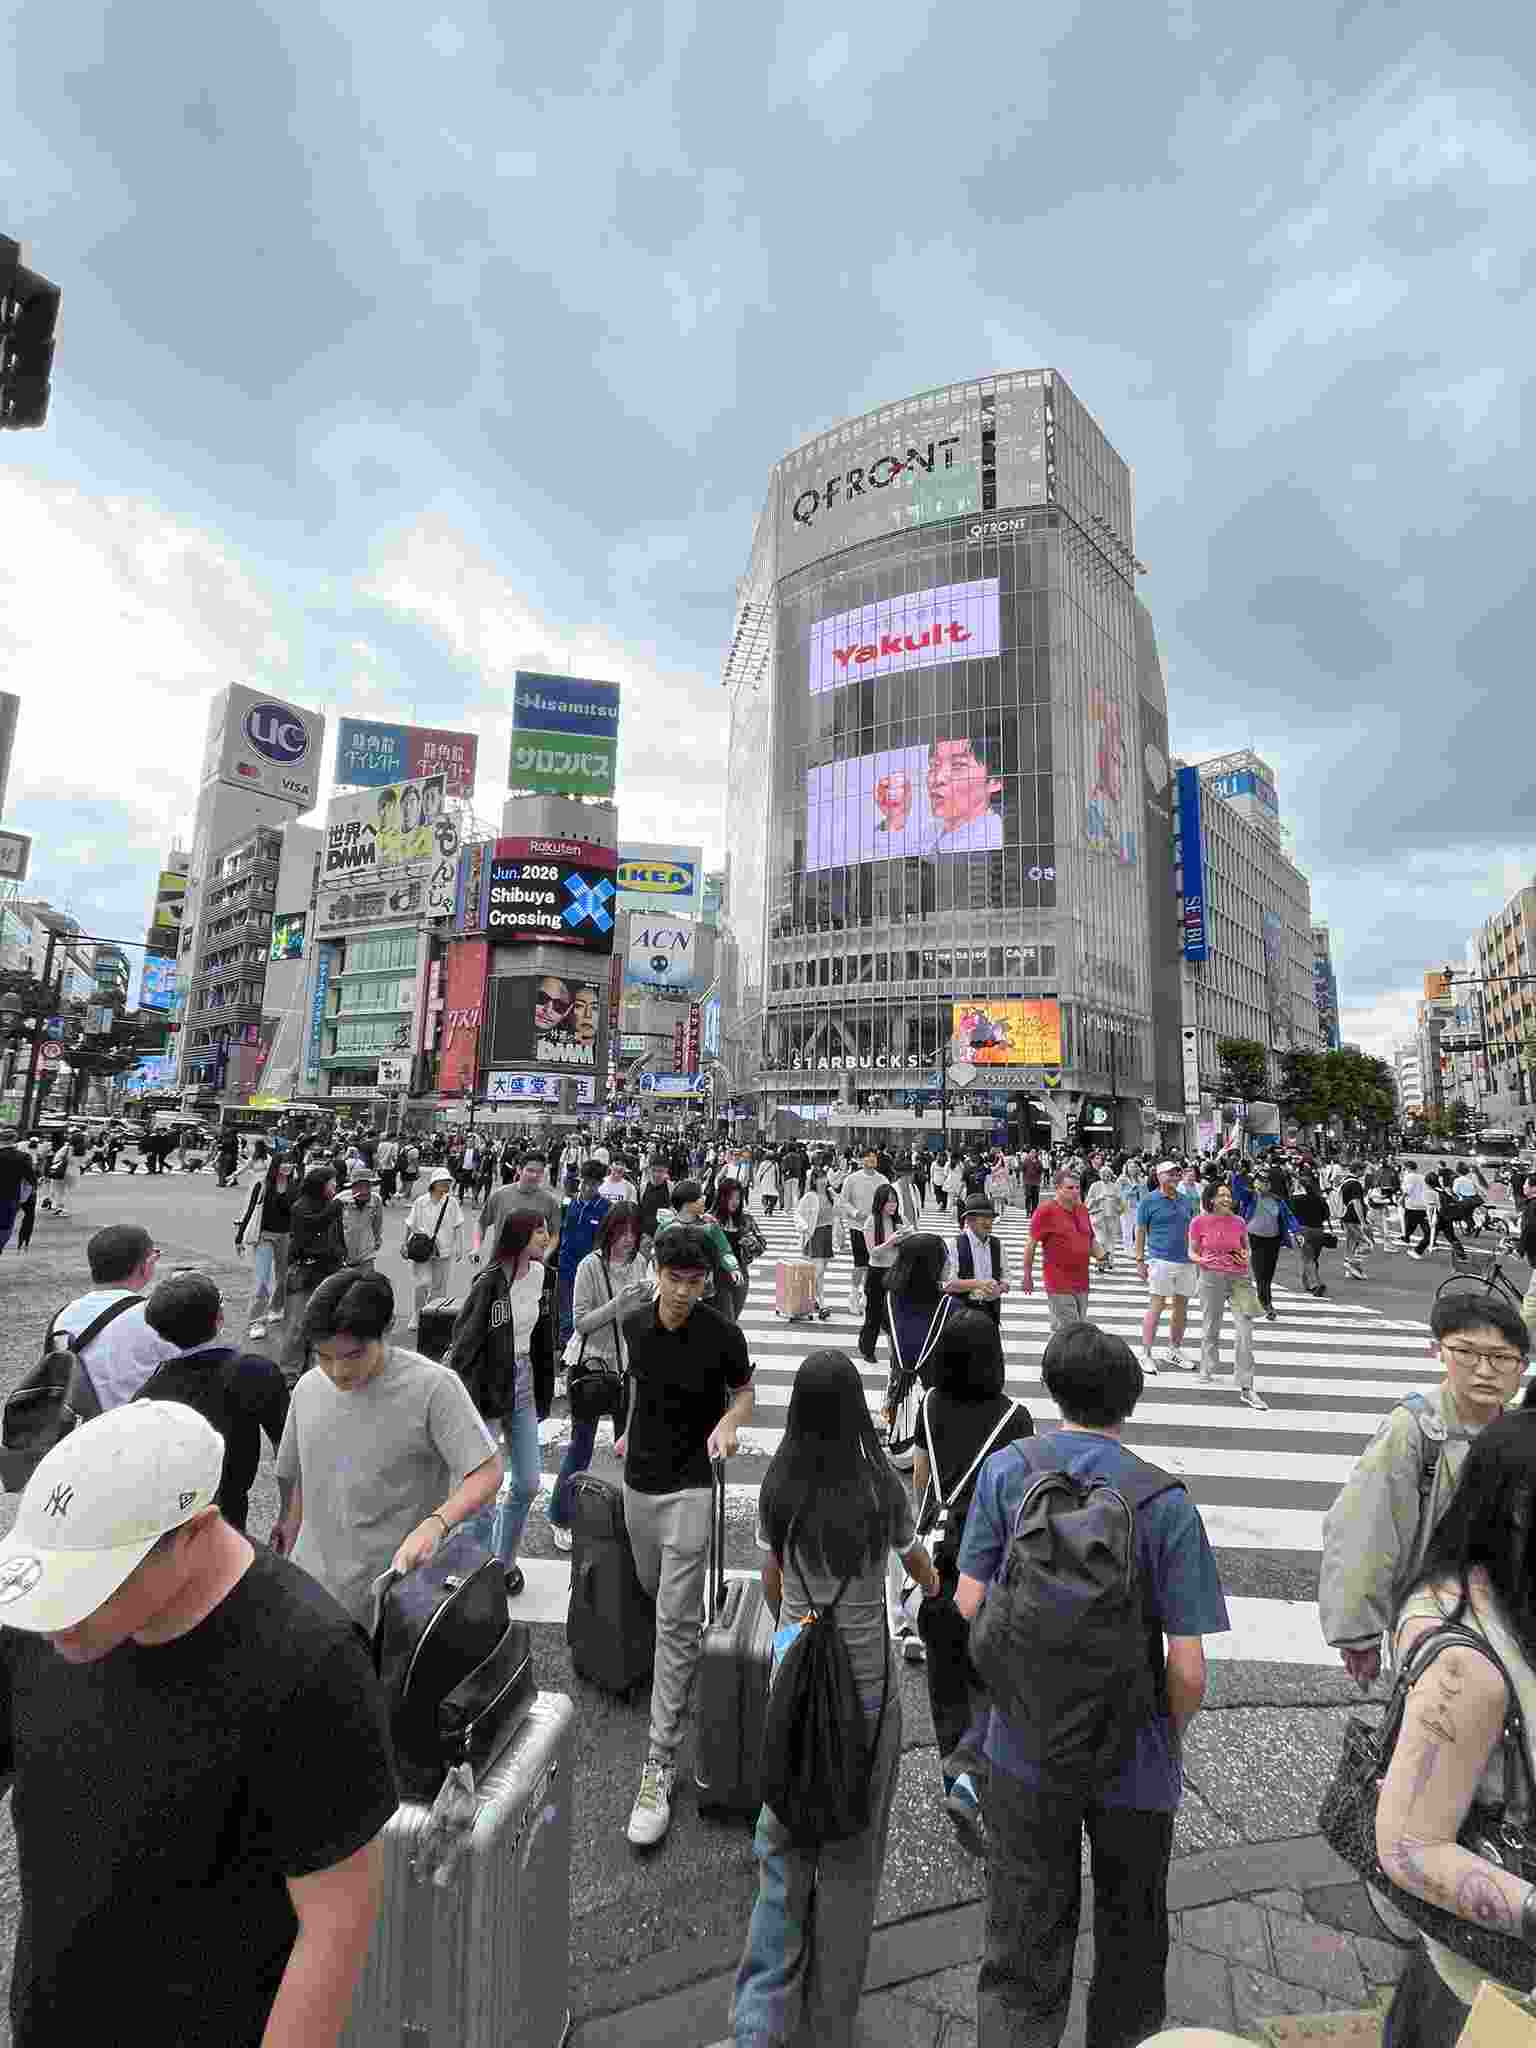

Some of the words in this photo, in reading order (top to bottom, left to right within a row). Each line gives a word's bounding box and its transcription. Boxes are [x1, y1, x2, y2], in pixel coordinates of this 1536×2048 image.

[792, 437, 960, 527] QFRONT
[969, 517, 1027, 538] QFRONT
[832, 622, 973, 668] Yakult
[527, 692, 617, 718] Hisamitsu
[251, 712, 304, 752] UC
[518, 748, 609, 778] サロンパス
[282, 778, 310, 795] VISA
[329, 822, 377, 849] 世界へ
[328, 843, 376, 872] DMM
[530, 841, 582, 856] Rakuten
[490, 887, 555, 905] Shibuya
[489, 910, 562, 930] Crossing
[631, 929, 691, 950] ACN
[792, 1054, 917, 1070] STARBUCKS
